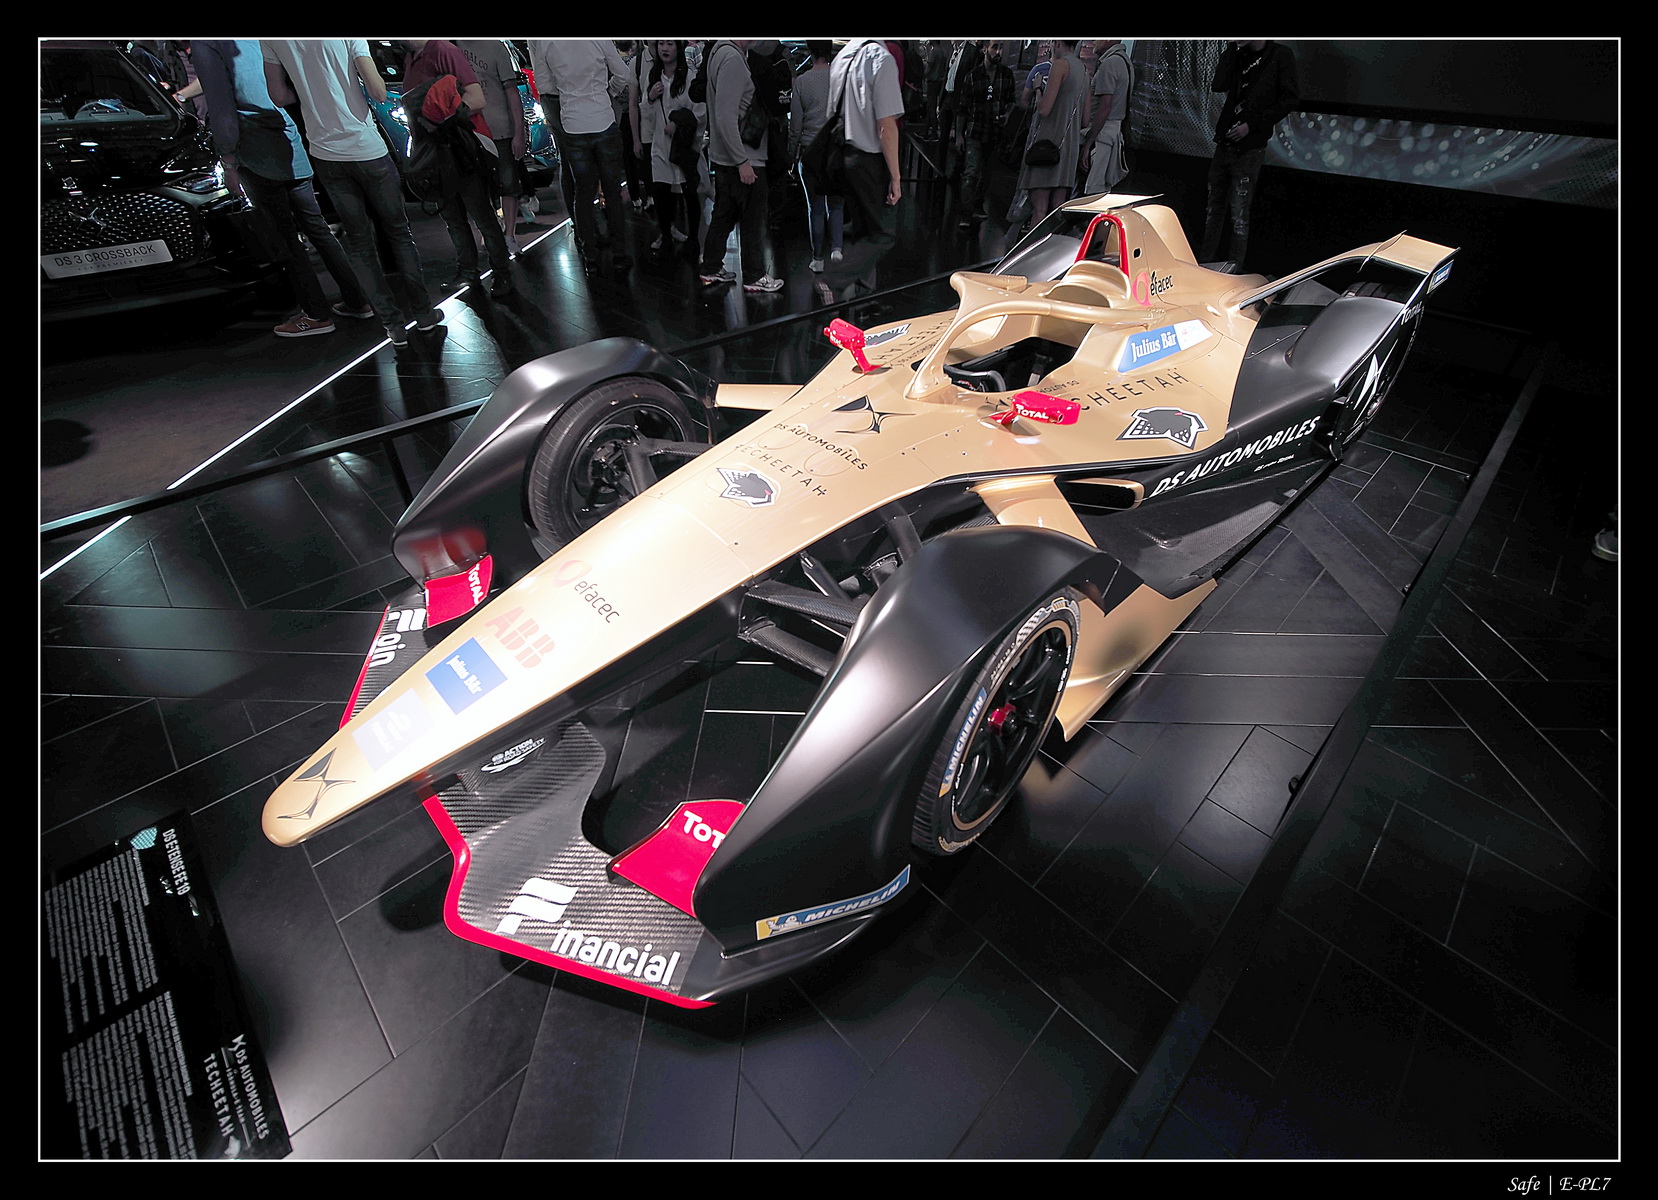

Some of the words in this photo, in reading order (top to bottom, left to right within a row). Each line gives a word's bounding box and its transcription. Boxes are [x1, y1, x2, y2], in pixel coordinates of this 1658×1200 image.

[54, 256, 72, 266] DS
[75, 254, 83, 264] 3
[84, 244, 156, 263] CROSSBACK
[1150, 271, 1174, 296] efacec
[1130, 338, 1160, 363] Julius
[1160, 331, 1177, 350] Bär
[1015, 403, 1050, 420] TOTAL
[773, 422, 788, 431] DS
[790, 425, 868, 471] AUTOMOBILES
[1149, 470, 1186, 498] DS
[1181, 416, 1321, 485] AUTOMOBILES
[735, 443, 828, 497] TECHEETAH
[467, 563, 485, 605] TOTAL
[574, 578, 620, 624] efacec
[484, 606, 556, 669] ABB
[446, 654, 470, 680] Julius
[463, 672, 484, 695] Bär
[503, 738, 534, 758] ACTION
[945, 696, 986, 773] MICHELIN
[162, 828, 178, 844] DS
[683, 811, 726, 849] TOT
[165, 840, 186, 876] E-TENSE
[176, 881, 191, 896] 19
[804, 881, 902, 924] MICHELIN
[235, 1049, 248, 1066] DS
[203, 1053, 235, 1138] TECHEETAH
[239, 1063, 269, 1140] AUTOMOBILES
